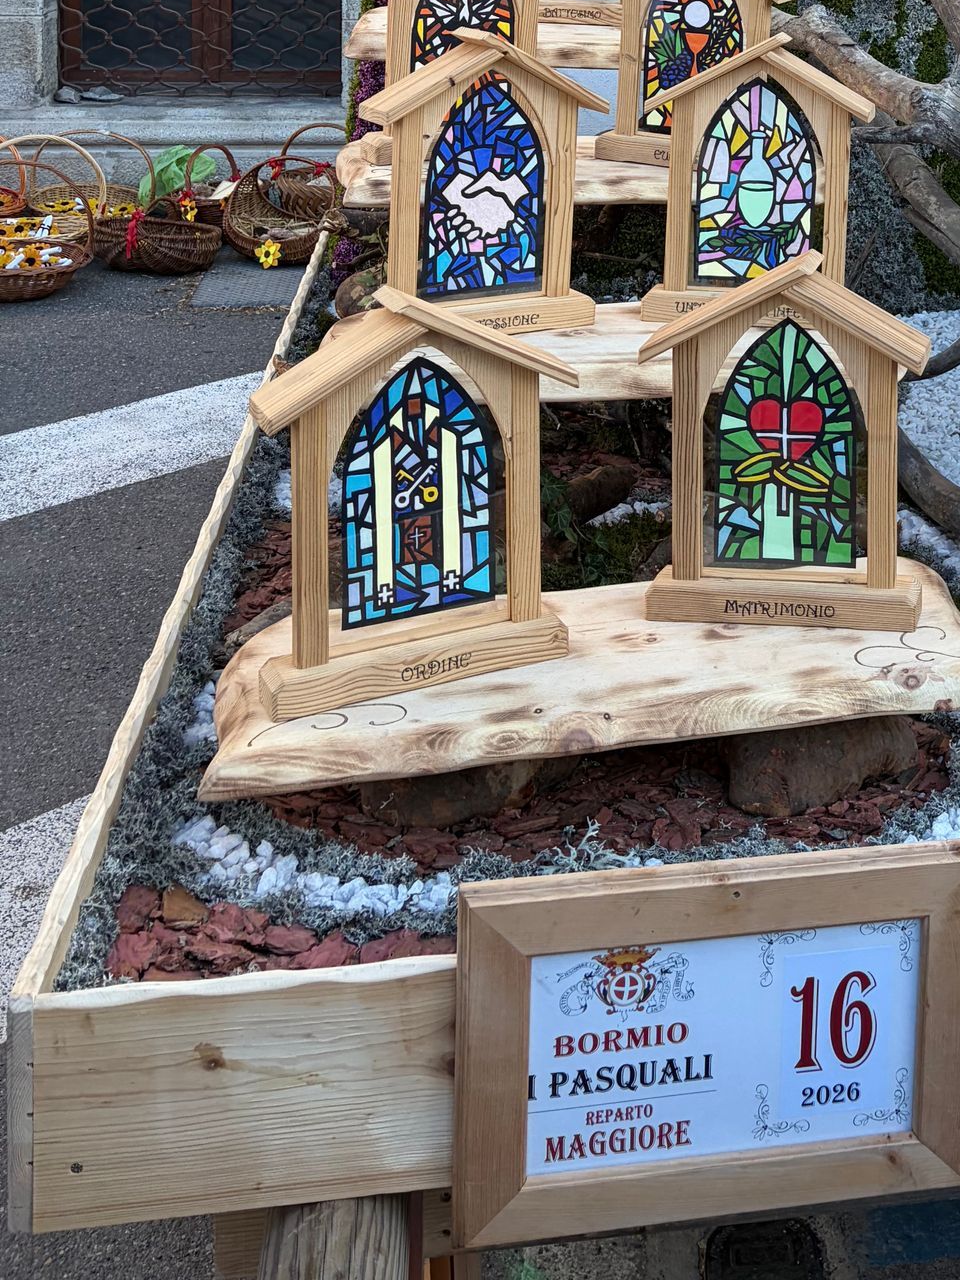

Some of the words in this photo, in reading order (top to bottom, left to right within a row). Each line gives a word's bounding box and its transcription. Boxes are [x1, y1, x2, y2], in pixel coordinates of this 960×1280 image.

[723, 599, 836, 618] MATRIMONIO
[401, 652, 472, 681] ORDINE
[790, 970, 878, 1074] 16
[553, 1022, 689, 1058] BORMIO
[528, 1074, 538, 1101] I
[548, 1054, 714, 1099] PASQUALI
[801, 1081, 861, 1107] 2026
[585, 1103, 654, 1126] REPARTO
[544, 1120, 692, 1163] MAGGIORE
